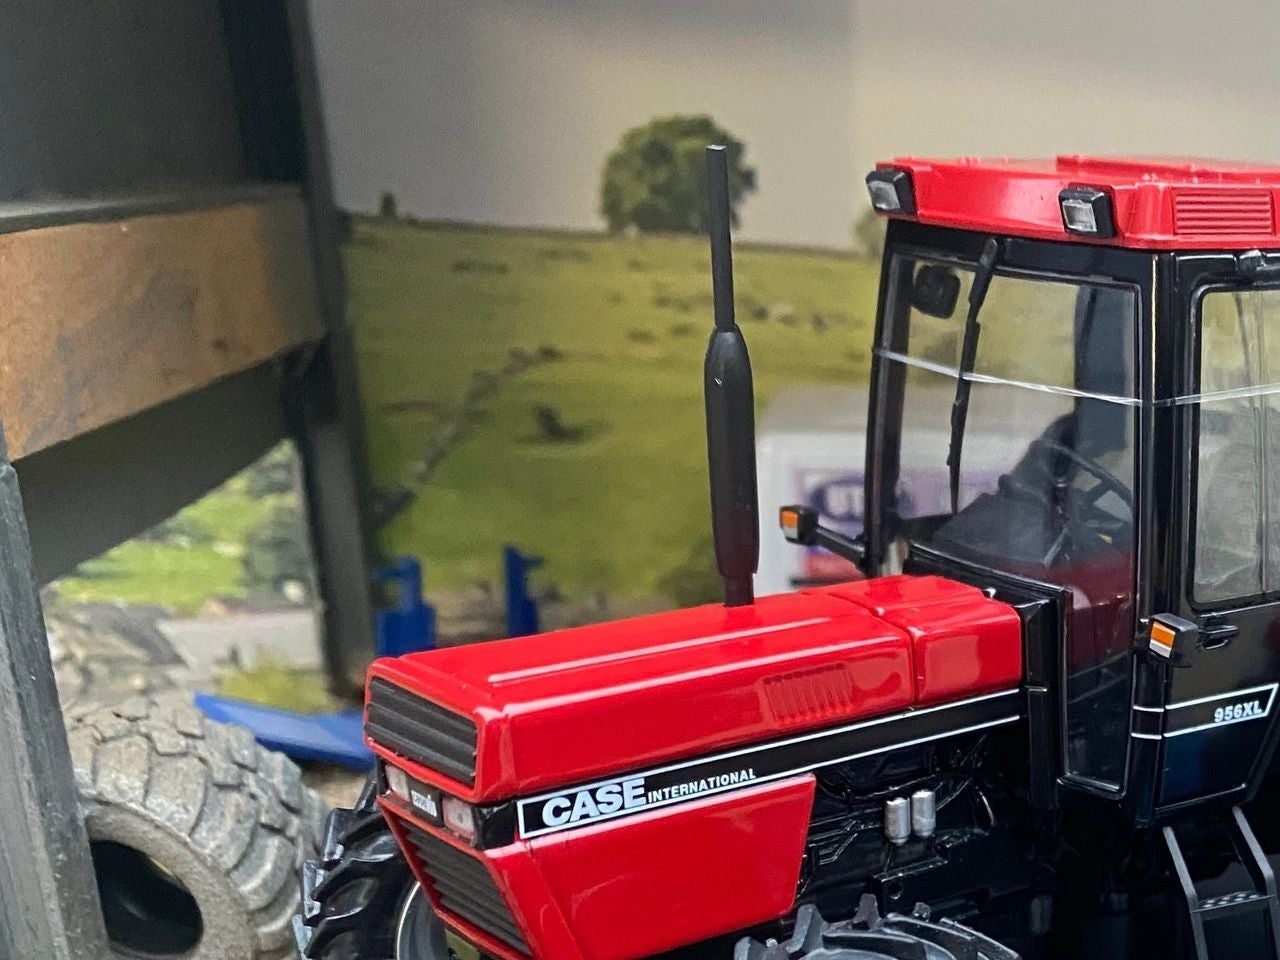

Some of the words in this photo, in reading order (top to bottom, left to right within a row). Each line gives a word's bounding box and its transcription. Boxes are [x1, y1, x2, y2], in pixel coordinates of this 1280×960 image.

[1214, 701, 1262, 722] 956XL
[542, 778, 646, 827] CASE
[648, 769, 757, 803] INTERNATIONAL
